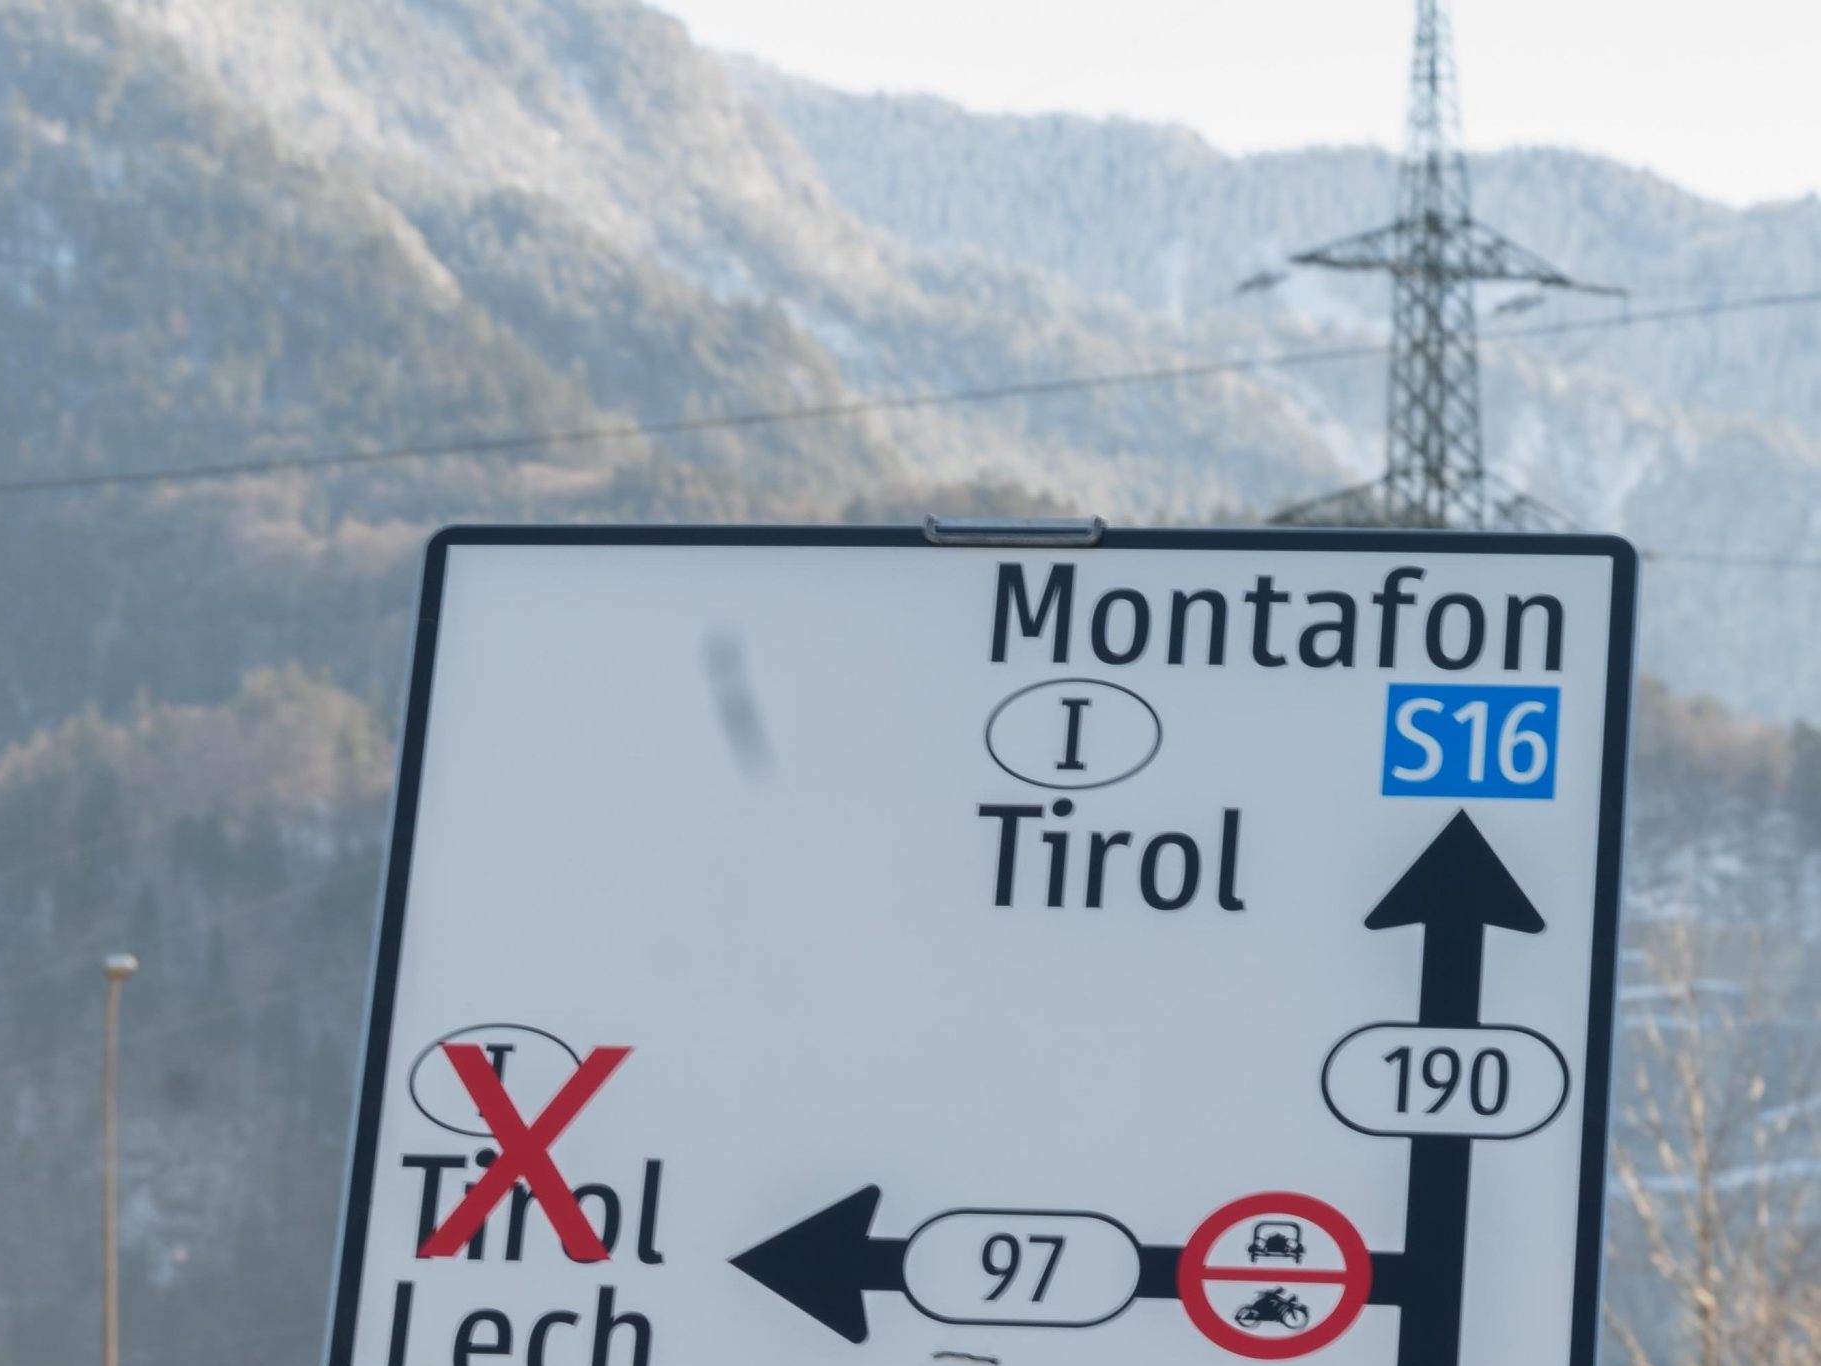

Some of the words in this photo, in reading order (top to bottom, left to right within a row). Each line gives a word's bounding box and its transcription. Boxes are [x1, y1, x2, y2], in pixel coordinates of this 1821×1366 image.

[989, 561, 1565, 673] Montafon
[1054, 697, 1092, 772] I
[1391, 697, 1550, 785] S16
[977, 797, 1246, 913] Tirol
[1383, 1045, 1510, 1117] 190
[980, 1232, 1066, 1303] 97
